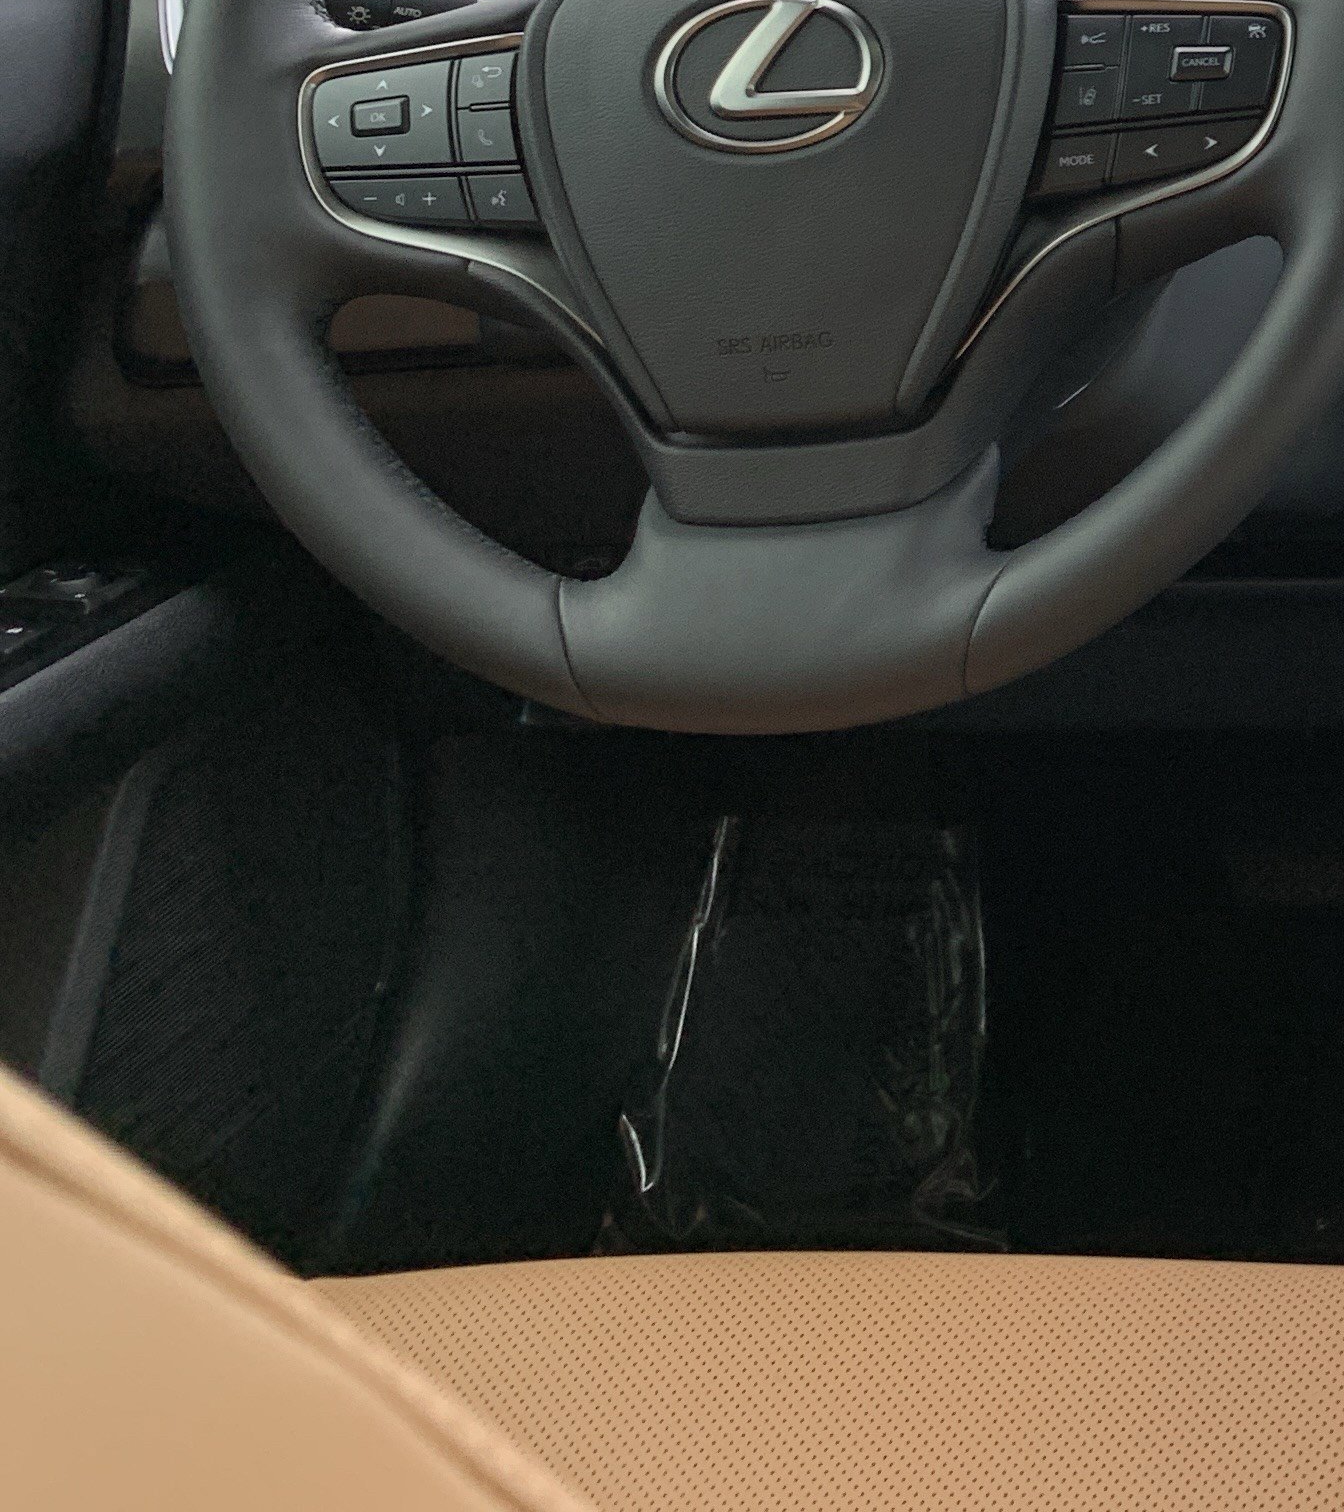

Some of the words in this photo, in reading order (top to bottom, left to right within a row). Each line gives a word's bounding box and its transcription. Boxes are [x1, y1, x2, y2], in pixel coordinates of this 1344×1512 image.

[392, 6, 423, 19] AUTO
[1181, 57, 1221, 68] CANCEL
[1058, 153, 1095, 168] MODE
